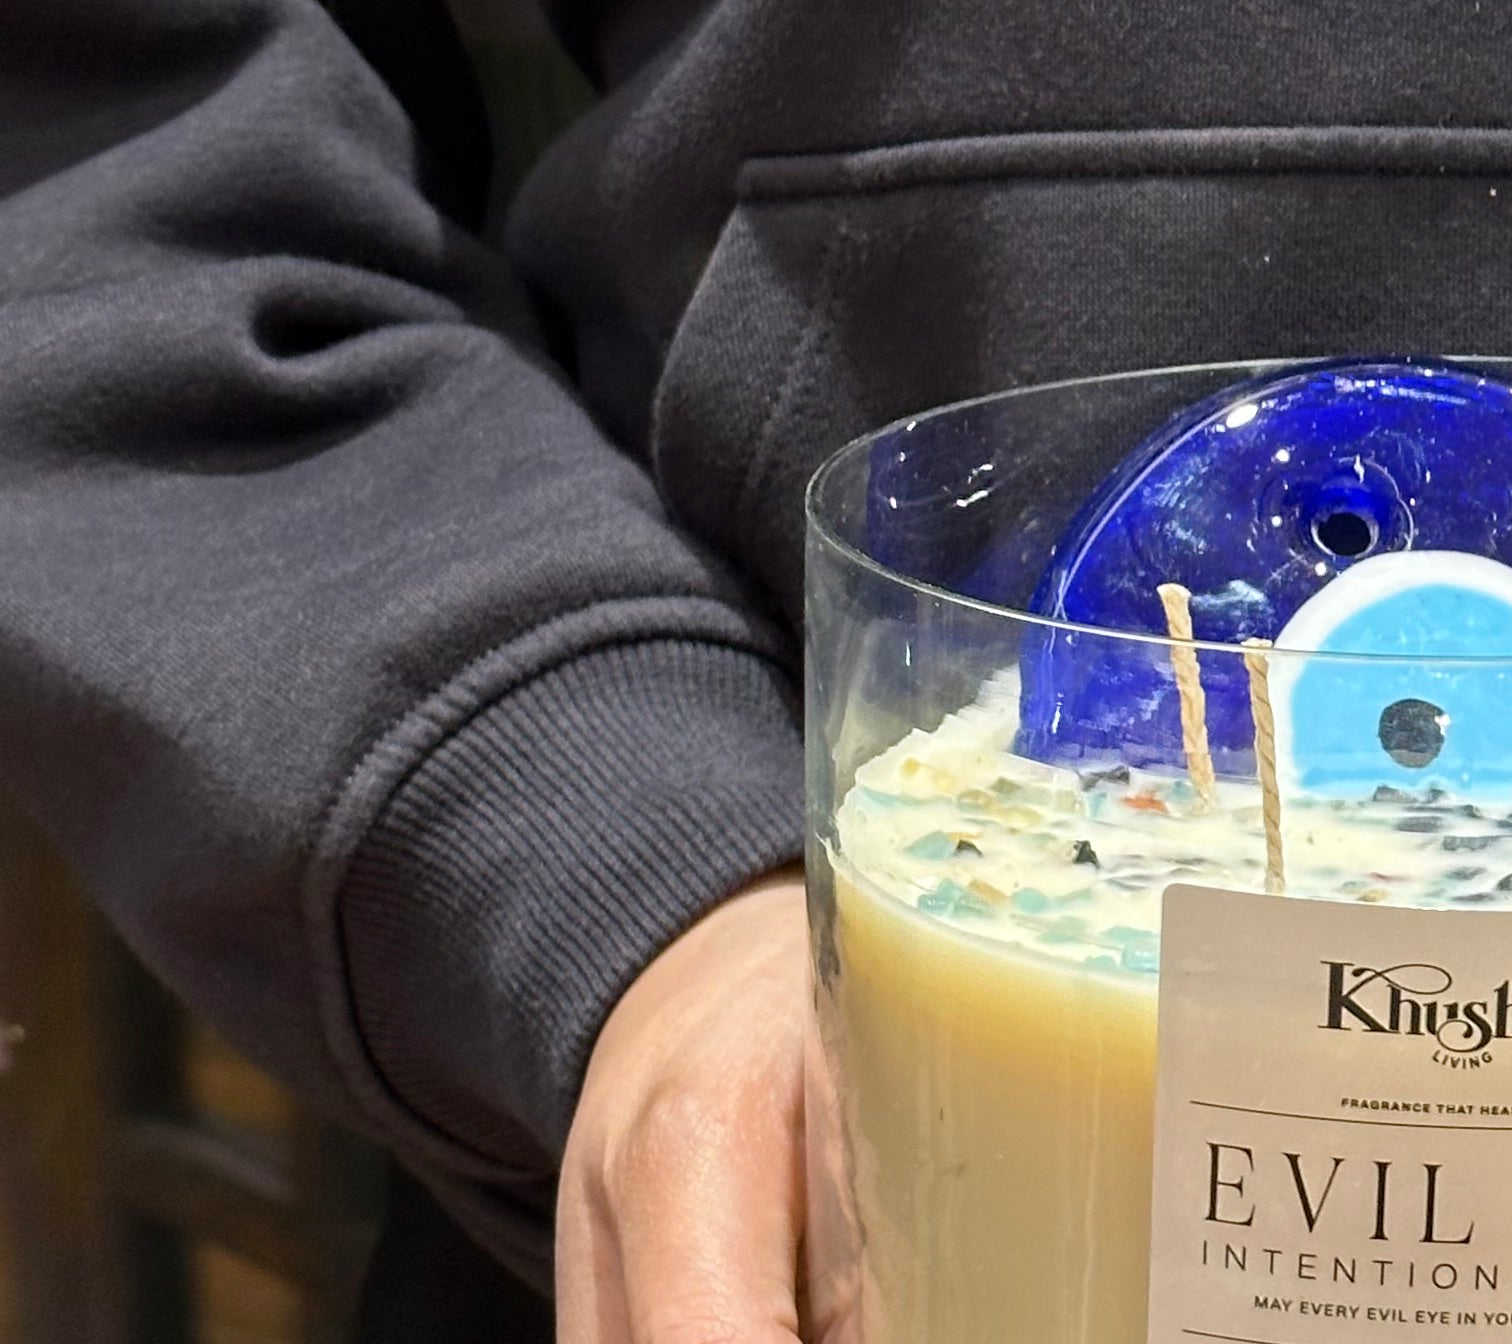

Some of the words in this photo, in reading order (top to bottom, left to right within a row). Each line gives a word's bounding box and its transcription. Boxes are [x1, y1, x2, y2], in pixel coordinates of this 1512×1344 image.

[1430, 1048, 1494, 1071] LIVING
[1340, 1097, 1432, 1114] FRAGRANCE
[1435, 1103, 1476, 1116] THAT
[1203, 1140, 1475, 1245] EVIL
[1202, 1240, 1499, 1293] INTENTION
[1253, 1295, 1294, 1313] MAY
[1298, 1300, 1361, 1321] EVERY
[1366, 1306, 1409, 1324] EVIL
[1414, 1309, 1452, 1327] EYE
[1456, 1311, 1477, 1326] IN
